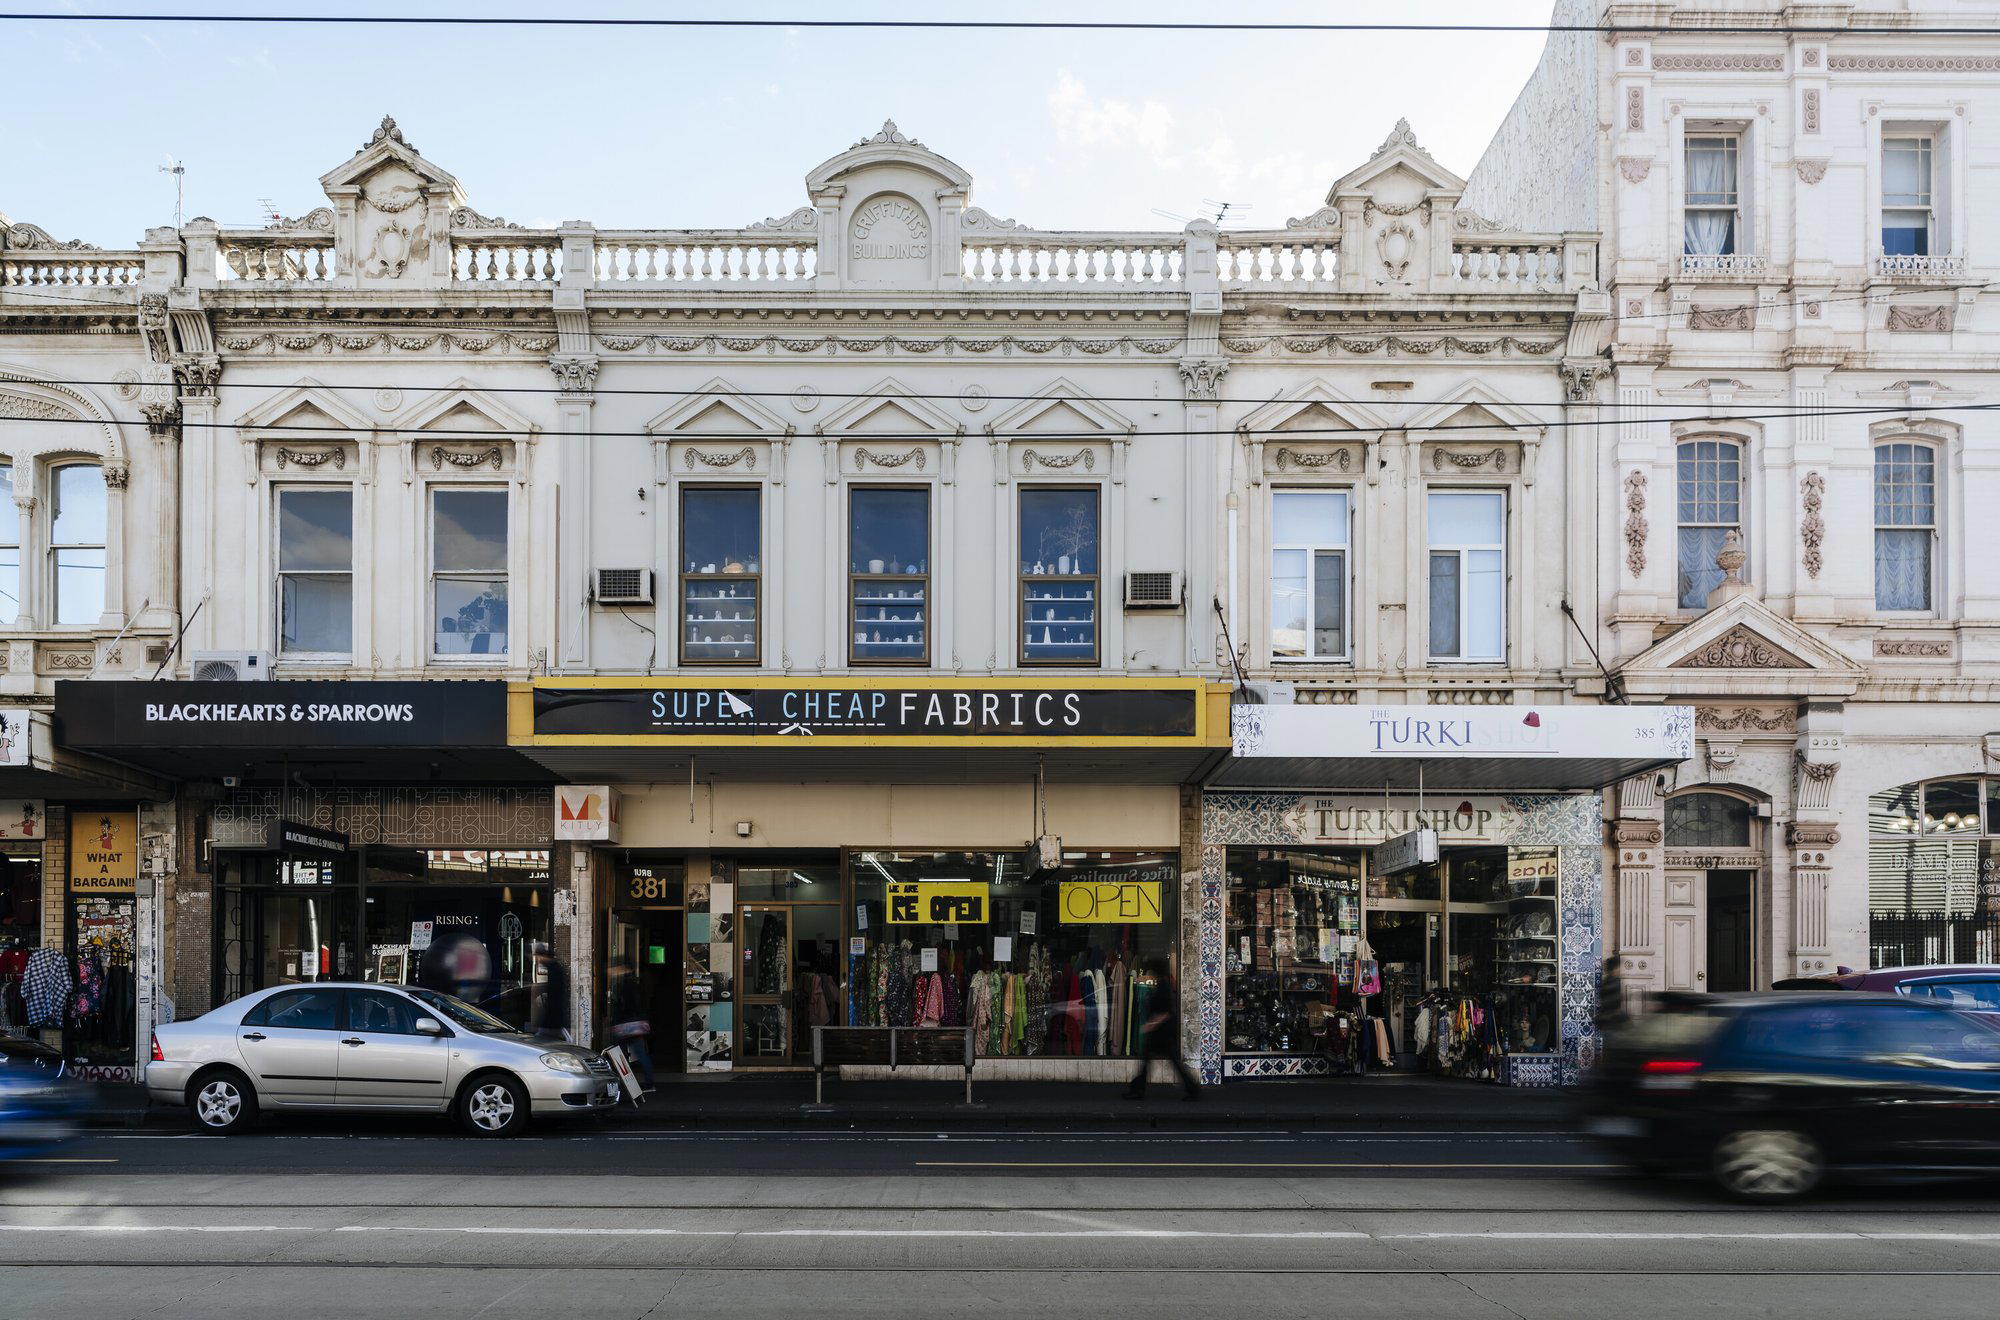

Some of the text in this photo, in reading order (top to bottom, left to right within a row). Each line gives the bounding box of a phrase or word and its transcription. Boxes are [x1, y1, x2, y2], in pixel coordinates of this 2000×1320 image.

[853, 243, 927, 259] BUILDINGS
[145, 704, 414, 721] BLACKHEARTS & SPARROWS
[783, 692, 886, 718] CHEAP
[900, 693, 1081, 726] FABRICS
[1370, 710, 1390, 719] THE
[1634, 728, 1655, 739] 385
[1315, 800, 1334, 808] THE
[561, 821, 602, 831] KITLY
[1314, 806, 1492, 836] TURKISHOP
[286, 831, 318, 847] BLACKHEARTS
[86, 853, 122, 862] WHAT
[1696, 856, 1721, 869] 387
[100, 865, 109, 874] A
[73, 878, 135, 887] BARGAIN!!
[630, 877, 667, 899] 381
[888, 885, 919, 893] WE ARE
[1066, 882, 1161, 919] OPEN
[892, 896, 919, 921] RE
[929, 896, 982, 921] OPEN
